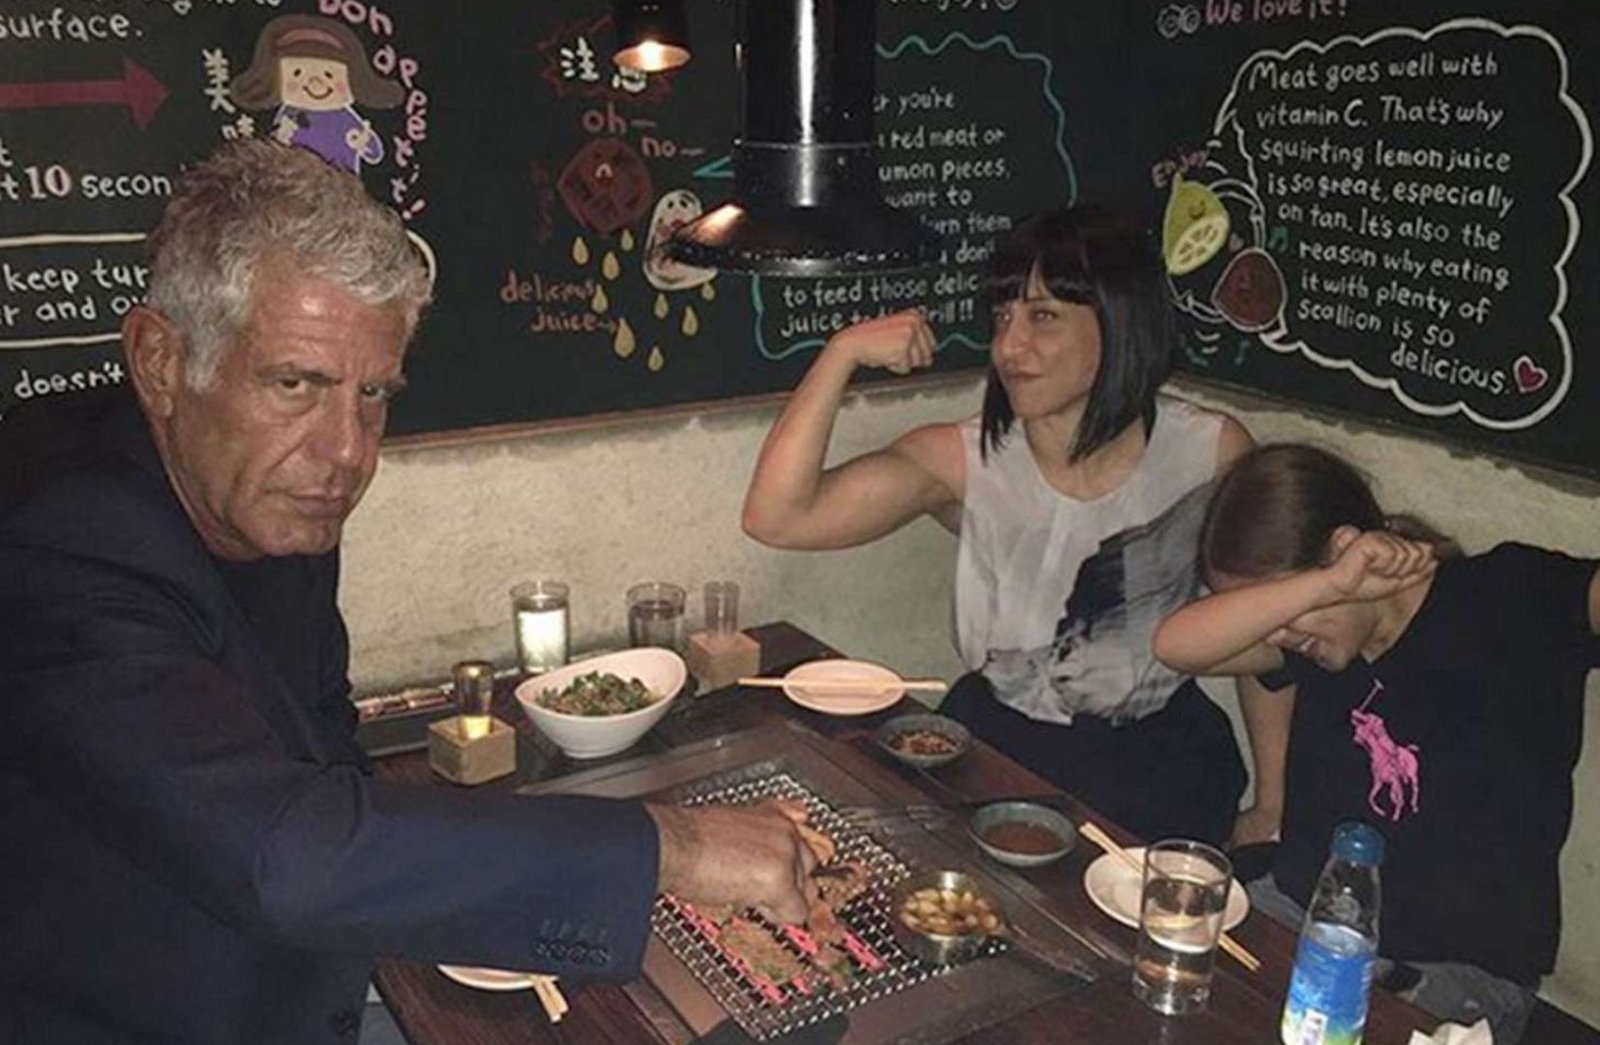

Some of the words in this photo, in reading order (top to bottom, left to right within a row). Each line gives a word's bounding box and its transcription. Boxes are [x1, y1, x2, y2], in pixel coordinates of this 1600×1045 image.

[1206, 0, 1243, 24] We
[1254, 0, 1301, 20] love
[1249, 61, 1318, 91] Meat
[1325, 60, 1379, 91] goes
[1388, 51, 1434, 78] well
[1441, 51, 1498, 76] with
[1256, 102, 1339, 129] vitamin
[1343, 98, 1367, 127] C.
[1380, 95, 1450, 125] That's
[1455, 101, 1503, 130] why
[891, 125, 924, 149] red
[930, 122, 977, 147] meat
[983, 128, 1004, 145] or
[1259, 138, 1364, 171] squirting
[1375, 139, 1444, 168] lemon
[1446, 148, 1511, 172] juice
[25, 164, 71, 199] 10
[81, 173, 172, 198] secon
[946, 184, 973, 206] to
[1268, 173, 1287, 195] is
[1393, 180, 1514, 218] especially
[1278, 203, 1301, 220] on
[1360, 207, 1393, 239] It's
[1400, 216, 1449, 242] also
[1461, 224, 1501, 250] the
[3, 264, 79, 294] keep
[1300, 241, 1376, 267] reason
[1383, 248, 1425, 279] why
[1430, 257, 1510, 291] eating
[784, 285, 807, 307] to
[814, 279, 862, 307] feed
[870, 277, 927, 301] those
[934, 271, 979, 295] delic
[1302, 269, 1319, 292] it
[1323, 274, 1369, 299] with
[1376, 281, 1450, 319] plenty
[1458, 297, 1491, 324] of
[35, 296, 97, 320] and
[781, 311, 845, 338] juice
[1393, 316, 1413, 339] is
